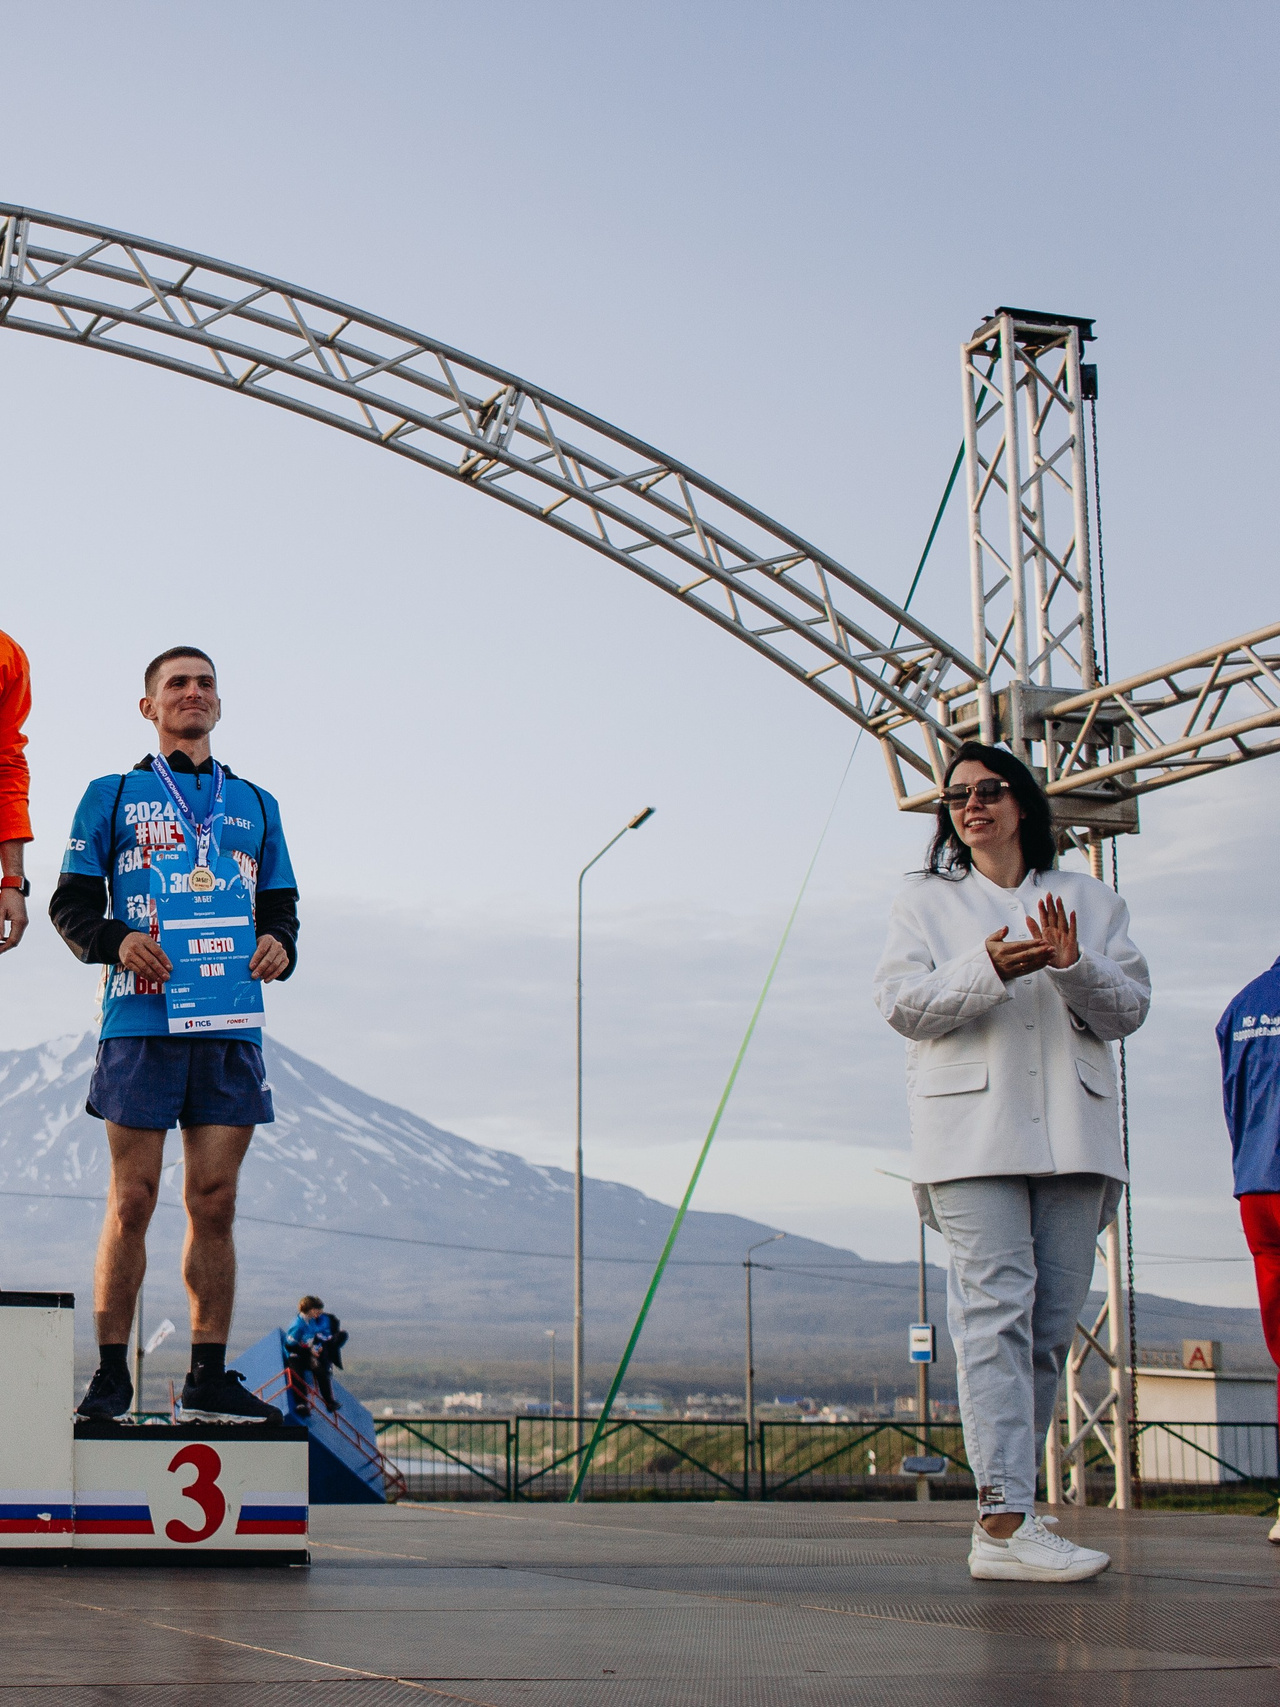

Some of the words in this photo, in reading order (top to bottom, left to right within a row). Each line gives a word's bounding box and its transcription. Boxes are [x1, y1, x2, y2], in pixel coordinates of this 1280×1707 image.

[124, 801, 176, 825] 2024
[199, 937, 234, 954] МЕСТО
[200, 964, 210, 977] 10
[211, 963, 225, 976] КМ
[165, 1443, 226, 1544] 3
